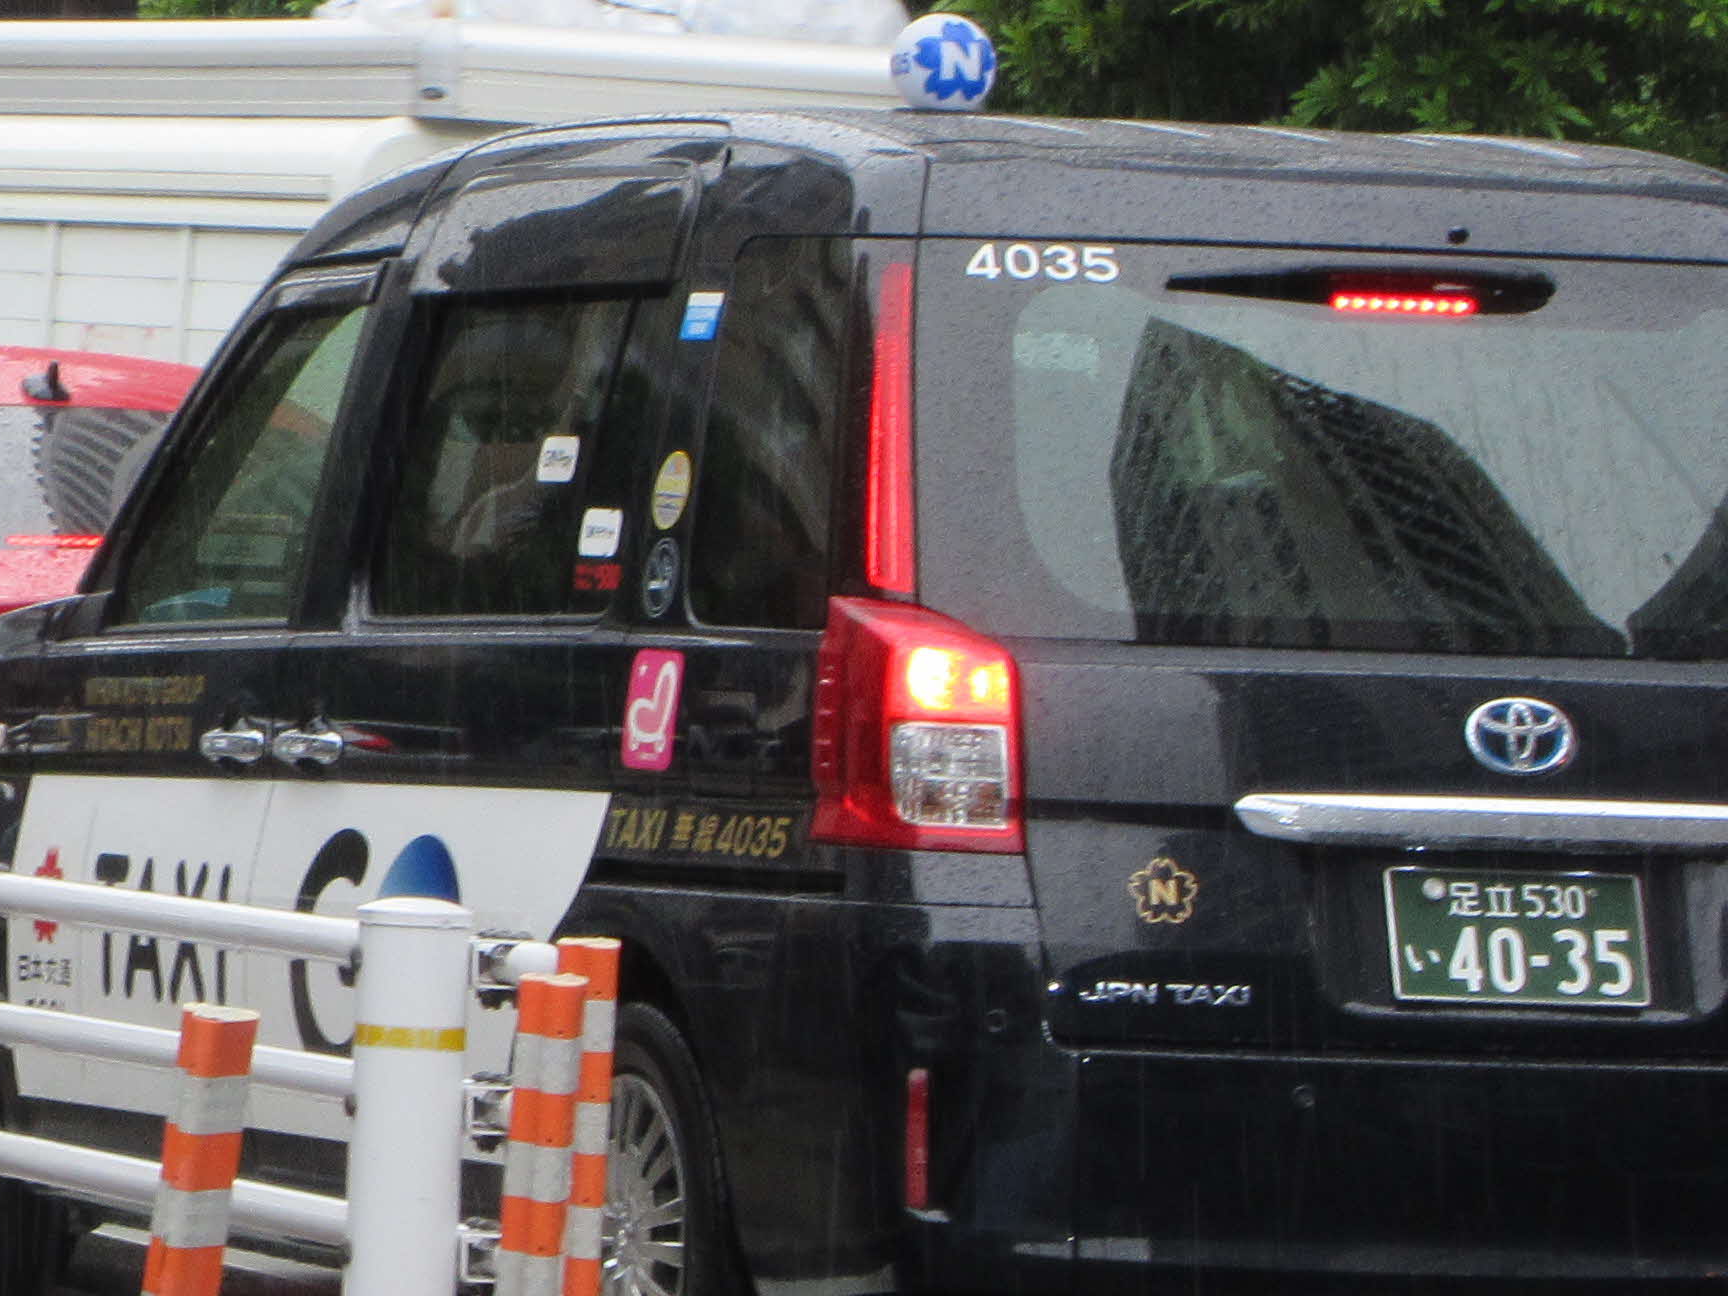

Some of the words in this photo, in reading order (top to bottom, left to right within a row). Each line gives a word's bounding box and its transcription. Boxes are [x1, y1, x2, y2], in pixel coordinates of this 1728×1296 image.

[939, 40, 982, 81] N
[965, 242, 1121, 283] 4035
[605, 808, 668, 849] TAXI
[1148, 877, 1181, 905] N
[95, 852, 232, 1005] TAXI
[1404, 943, 1442, 974] い
[1448, 924, 1634, 997] 40-35
[1078, 980, 1159, 1004] JPN
[1165, 982, 1252, 1005] TAXI
